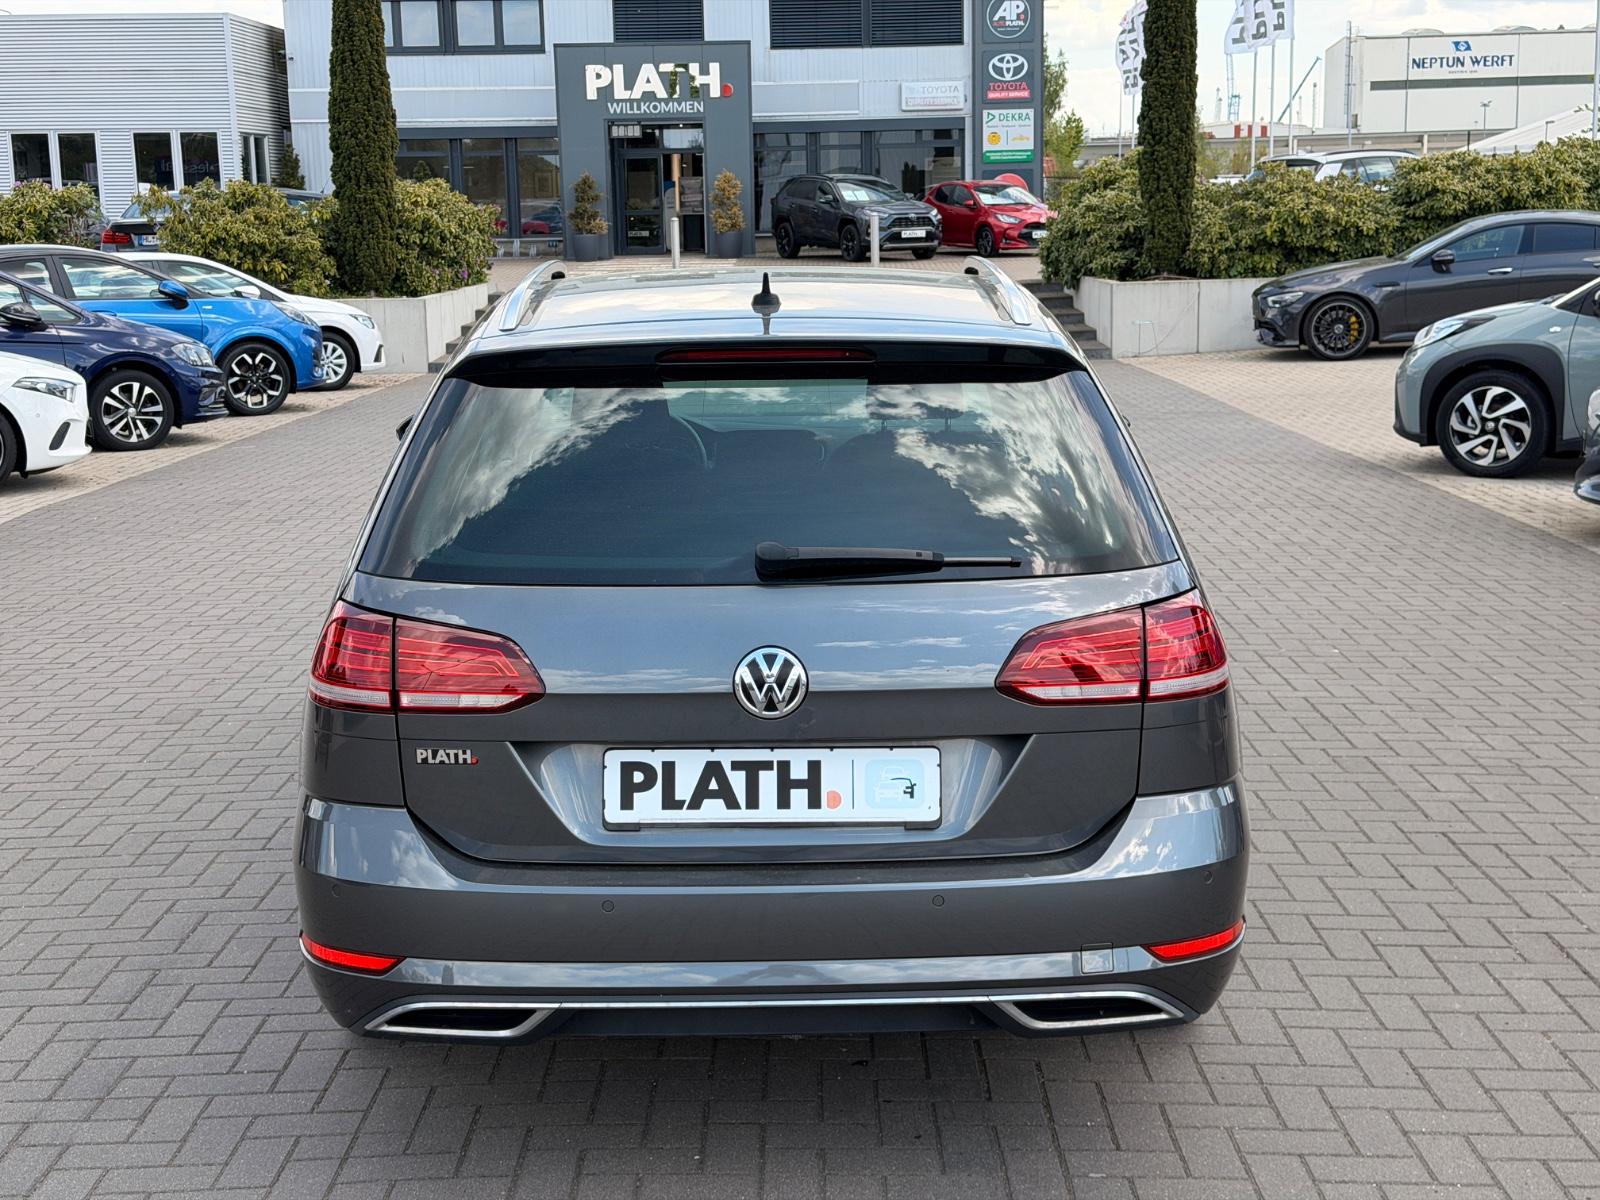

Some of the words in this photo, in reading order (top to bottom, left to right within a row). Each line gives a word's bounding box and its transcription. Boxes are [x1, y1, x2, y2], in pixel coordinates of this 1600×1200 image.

[1412, 57, 1465, 69] NEPTUN
[1469, 55, 1515, 68] WERFT
[921, 85, 960, 95] TOYOTA
[989, 81, 1028, 91] TOYOTA
[607, 101, 704, 114] WILLKOMMEN
[998, 112, 1031, 122] DEKRA
